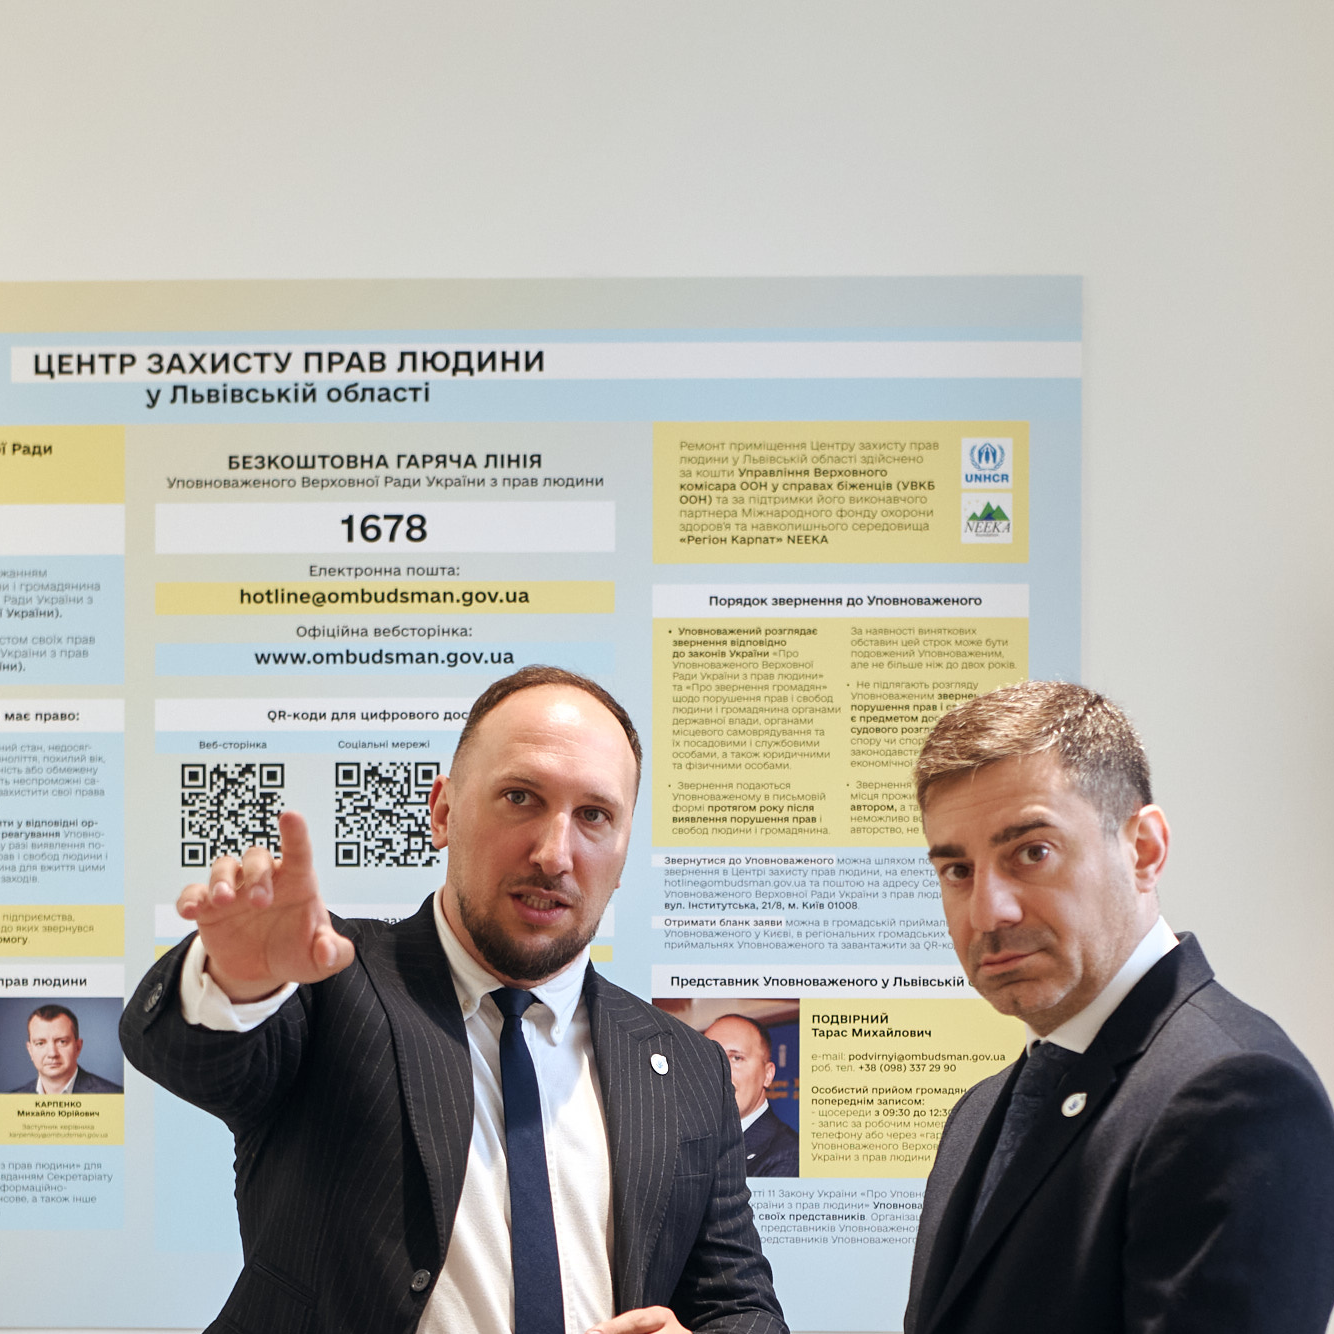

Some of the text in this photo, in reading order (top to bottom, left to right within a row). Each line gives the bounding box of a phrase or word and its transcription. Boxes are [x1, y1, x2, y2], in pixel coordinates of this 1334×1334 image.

[33, 350, 543, 379] ЦЕНТР ЗАХИСТУ ПРАВ ЛЮДИНИ
[145, 381, 429, 409] у Львівській області
[11, 442, 53, 456] Ради
[679, 440, 939, 452] Ремонт приміщення Центру захисту прав
[227, 453, 541, 470] БЕЗКОШТОВНА ГАРЯЧА ЛІНІЯ
[679, 453, 924, 466] людини у Львівській області здійснено
[679, 467, 888, 479] за кошти Управління Верховного
[964, 473, 1009, 484] UNHCR
[166, 474, 604, 490] Уповноваженого Верховної Ради України з прав людини
[679, 480, 935, 493] комісара ООН у справах біженців (УВКБ
[678, 494, 928, 505] ООН) та за підтримки його виконавчого
[340, 513, 427, 543] 1678
[964, 520, 1011, 534] NEEKA
[679, 534, 829, 546] «Регіон Карпат» NEEKA
[308, 564, 460, 579] Електронна пошта:
[239, 588, 530, 607] hotline@ombudsman.gov.ua
[708, 595, 982, 608] Порядок звернення до Уповноваженого
[295, 624, 472, 639] Офіційна вебсторінка:
[677, 626, 817, 637] Уповноважений розглядає
[254, 648, 514, 668] www.ombudsman.gov.ua
[4, 712, 30, 721] має
[34, 712, 79, 723] право:
[266, 709, 327, 722] QR-коди
[330, 711, 356, 721] для
[360, 709, 439, 722] цифрового
[198, 740, 267, 750] Веб-сторінка
[337, 739, 430, 750] Соціальні мережі
[663, 902, 685, 911] вул.
[687, 901, 759, 911] Інститутська,
[761, 900, 785, 910] 21/8,
[801, 901, 825, 909] Київ
[826, 901, 858, 910] 01008
[32, 977, 87, 988] людини
[670, 976, 759, 988] Представник
[762, 976, 878, 987] Уповноваженого
[880, 978, 889, 989] у
[892, 976, 964, 987] Львівській
[811, 1012, 888, 1025] ПОДВІРНИЙ
[810, 1027, 932, 1039] Тарас Михайлович
[811, 1052, 1006, 1064] e-mail: podvirnyi@ombudsman.gov.ua
[858, 1063, 957, 1072] +38 (098) 337 29 90
[810, 1085, 868, 1094] Особистий
[871, 1086, 912, 1095] прийом
[810, 1097, 874, 1106] попереднім
